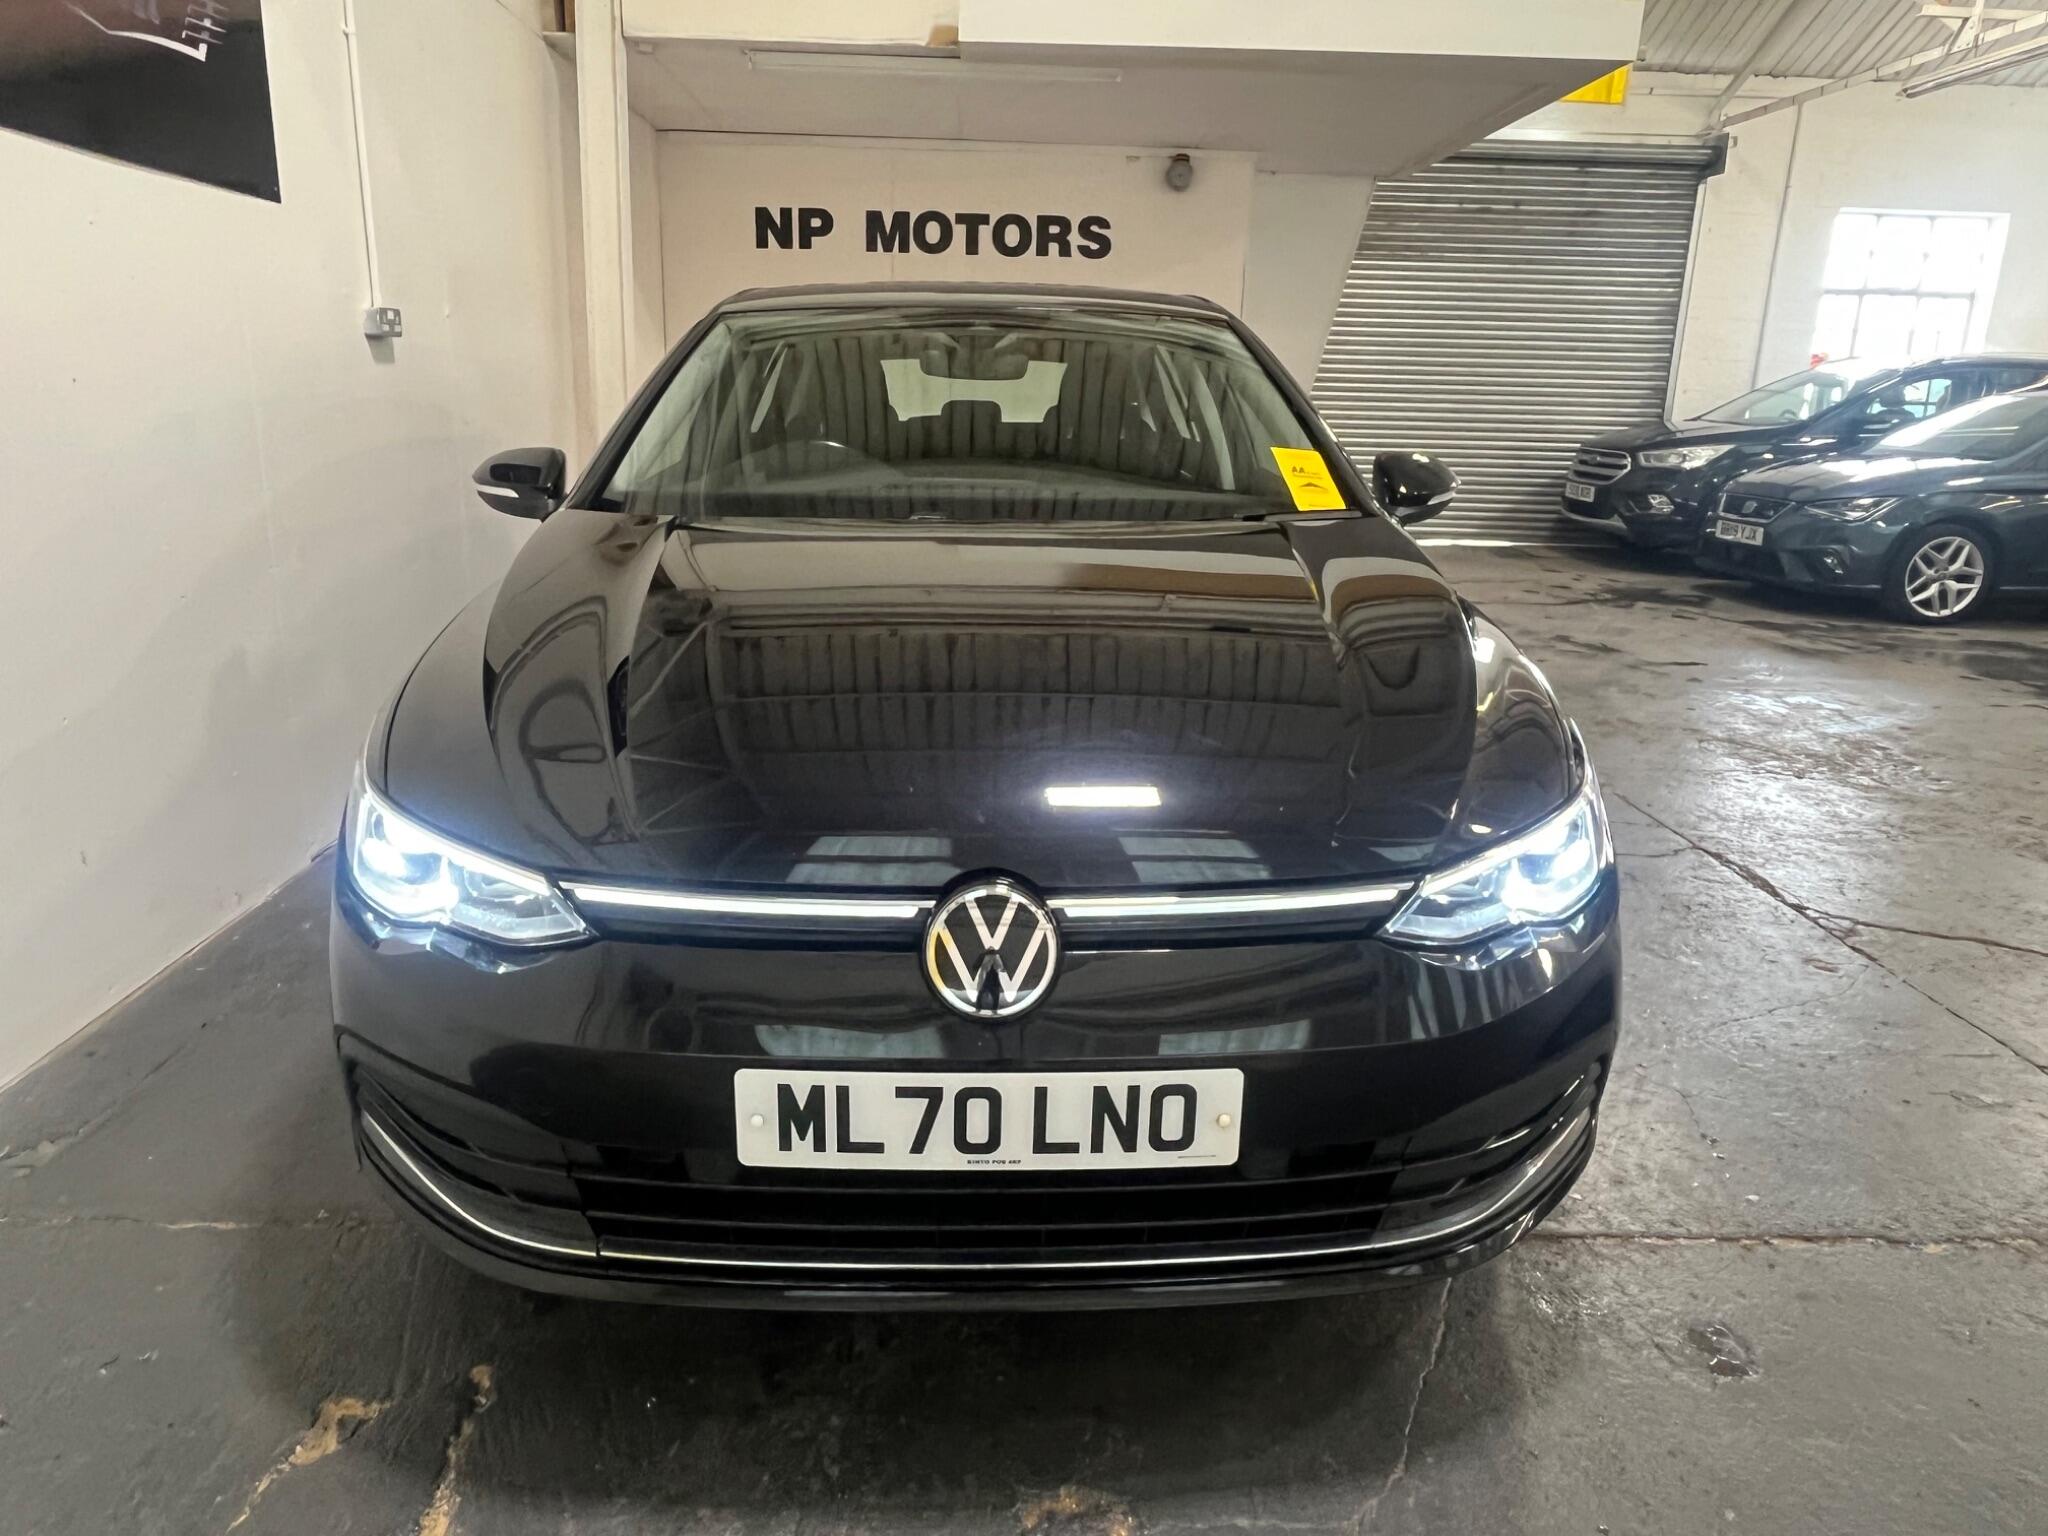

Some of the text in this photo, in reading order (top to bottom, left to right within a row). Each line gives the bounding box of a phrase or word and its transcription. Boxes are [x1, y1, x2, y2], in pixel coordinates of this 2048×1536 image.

[755, 207, 1112, 259] NP MOTORS
[778, 1084, 1197, 1155] ML70 LNO
